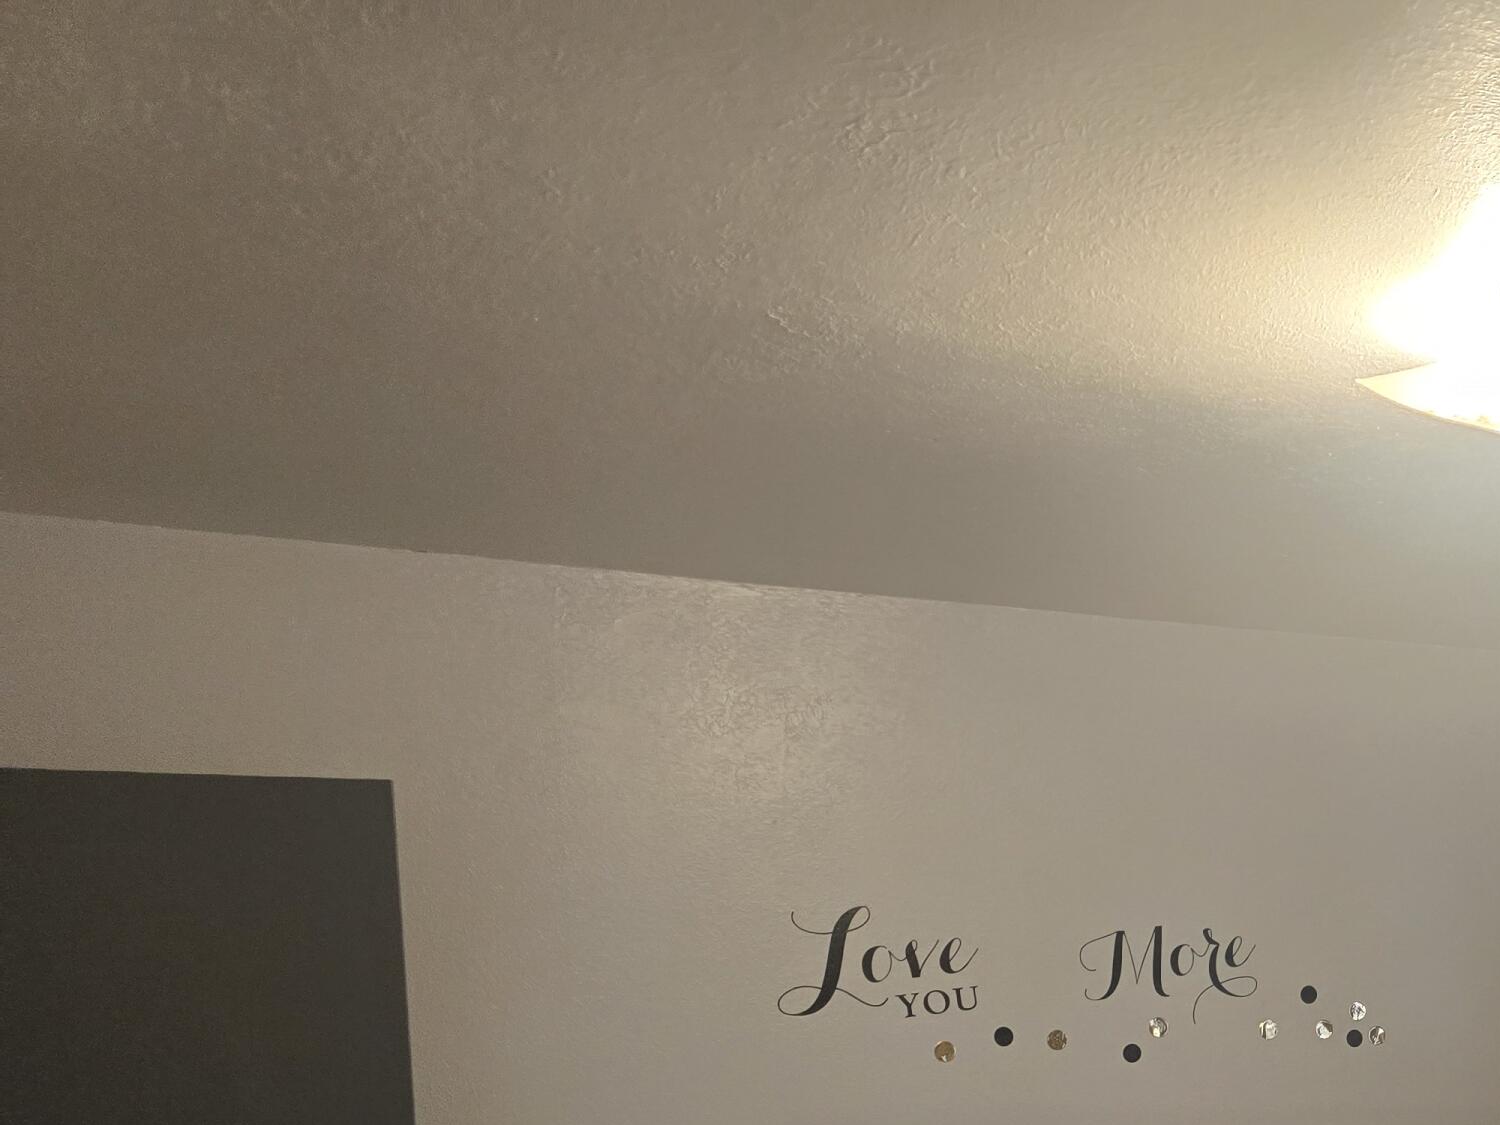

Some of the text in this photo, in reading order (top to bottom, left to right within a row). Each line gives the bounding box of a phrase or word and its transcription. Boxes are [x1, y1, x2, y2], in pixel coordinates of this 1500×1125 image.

[778, 905, 1258, 1024] Love YOU More
